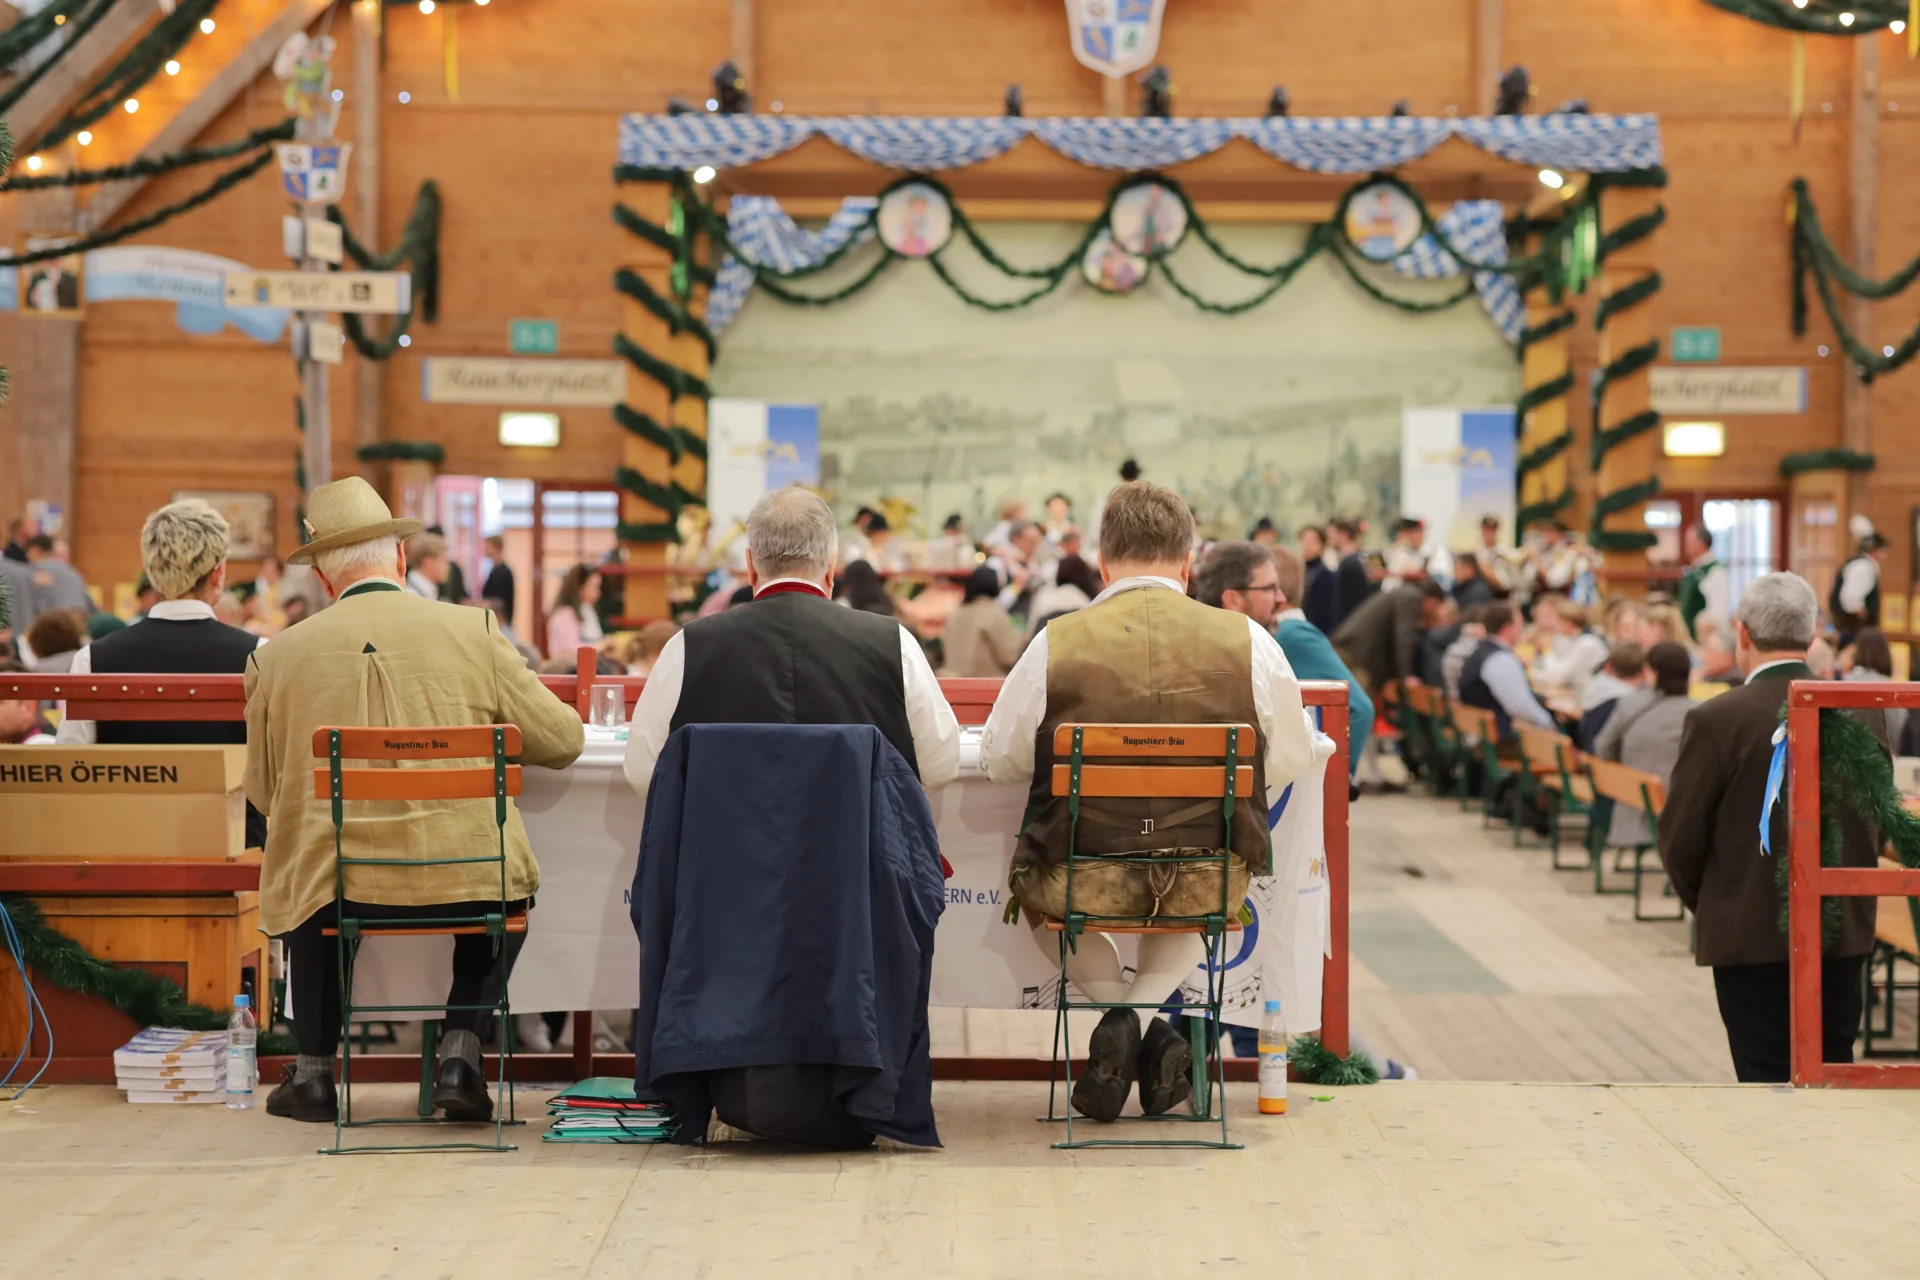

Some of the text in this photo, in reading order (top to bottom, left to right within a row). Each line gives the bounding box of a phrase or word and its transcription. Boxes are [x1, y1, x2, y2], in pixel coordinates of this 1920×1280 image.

[384, 740, 429, 750] Augustiner
[1123, 736, 1166, 746] Augustiner
[0, 761, 178, 783] HIER ÖFFNEN
[976, 889, 1001, 905] e.V.
